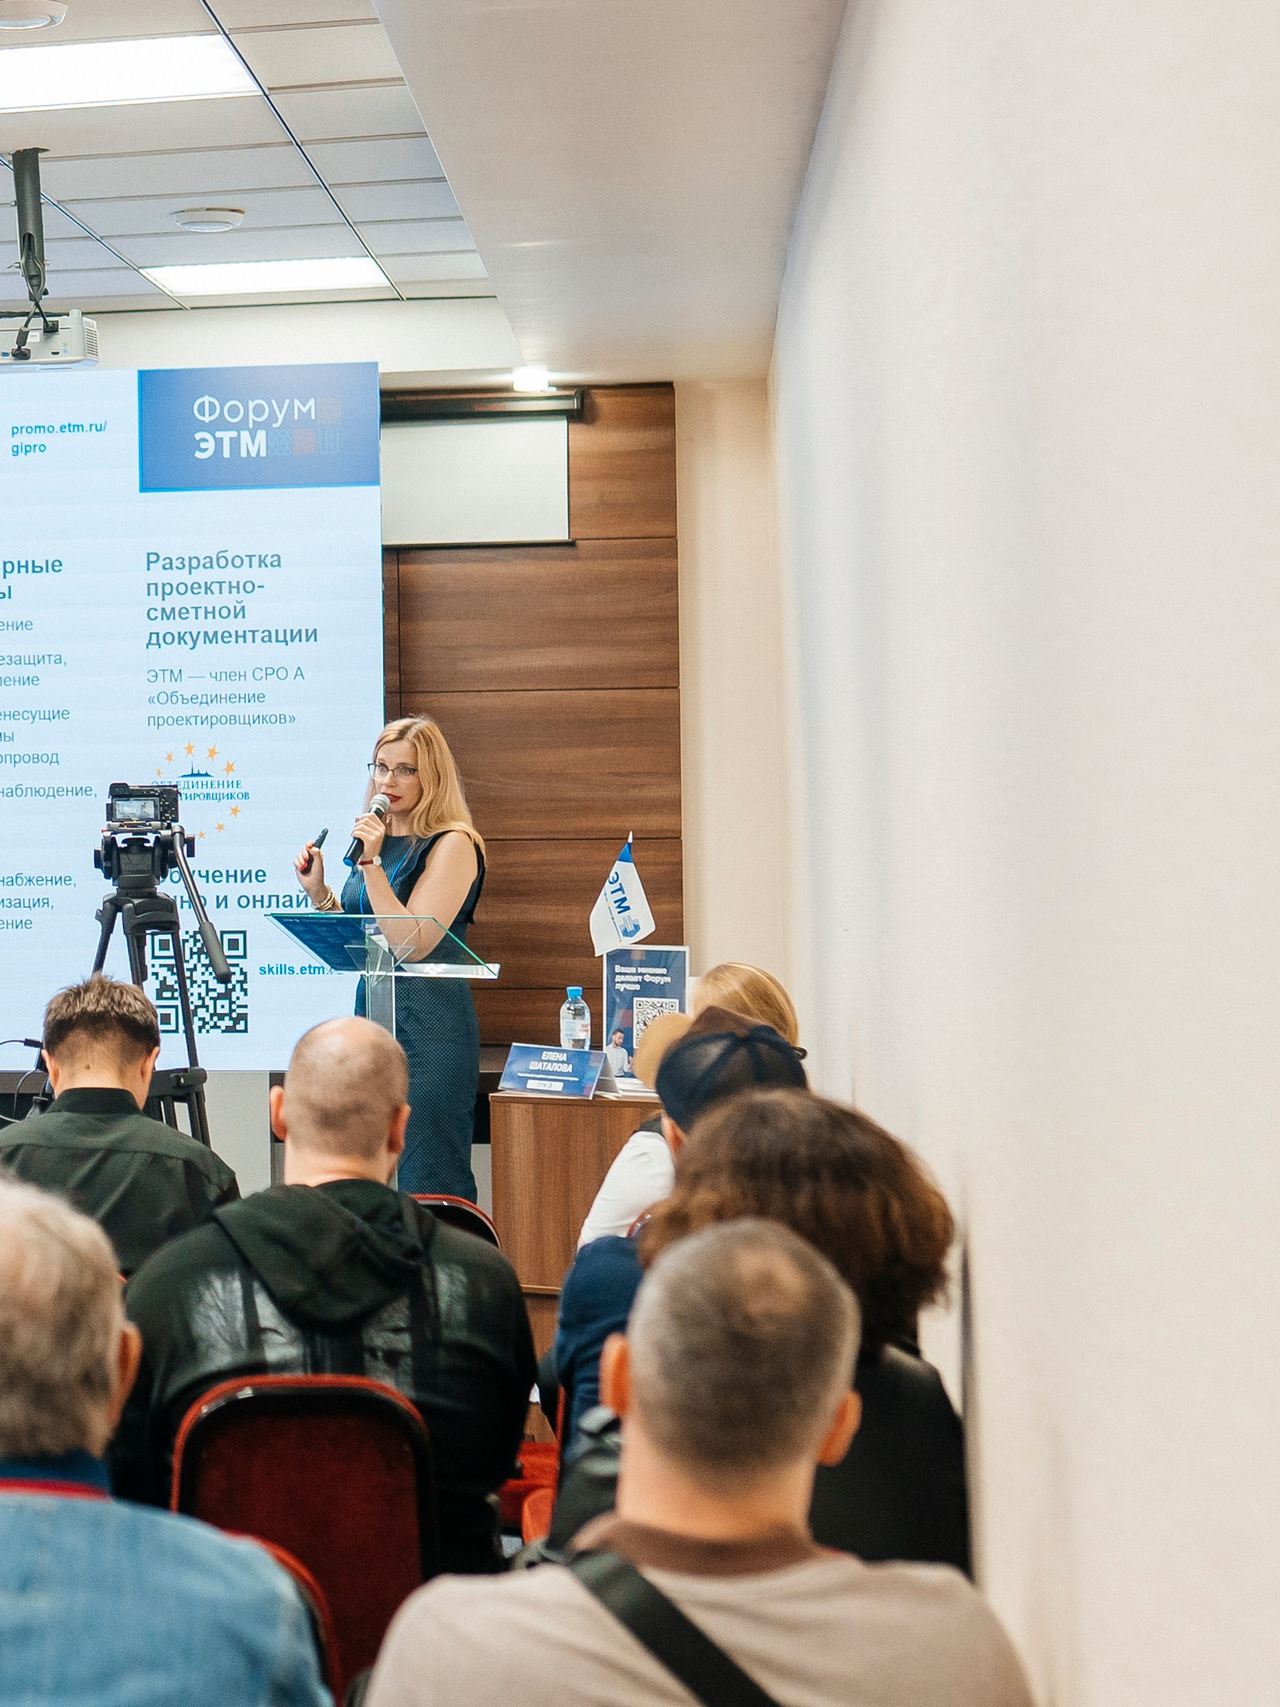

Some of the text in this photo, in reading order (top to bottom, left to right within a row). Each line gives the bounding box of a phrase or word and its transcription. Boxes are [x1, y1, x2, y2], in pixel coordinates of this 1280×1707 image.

[193, 395, 316, 429] Форум
[12, 421, 107, 438] promo.etm.ru/
[12, 442, 46, 456] gipro
[194, 430, 267, 460] ЭТМ
[147, 550, 281, 575] Разработка
[147, 580, 264, 604] проектно-
[147, 600, 245, 621] сметной
[146, 628, 317, 650] документации
[147, 669, 182, 683] ЭТМ
[209, 671, 246, 681] член
[252, 667, 288, 681] СРО
[294, 666, 305, 680] А
[148, 691, 265, 706] «Объединение
[148, 714, 296, 730] проектировщиков»
[216, 895, 228, 909] и
[237, 889, 312, 908] онлай
[607, 870, 632, 914] ЭТМ
